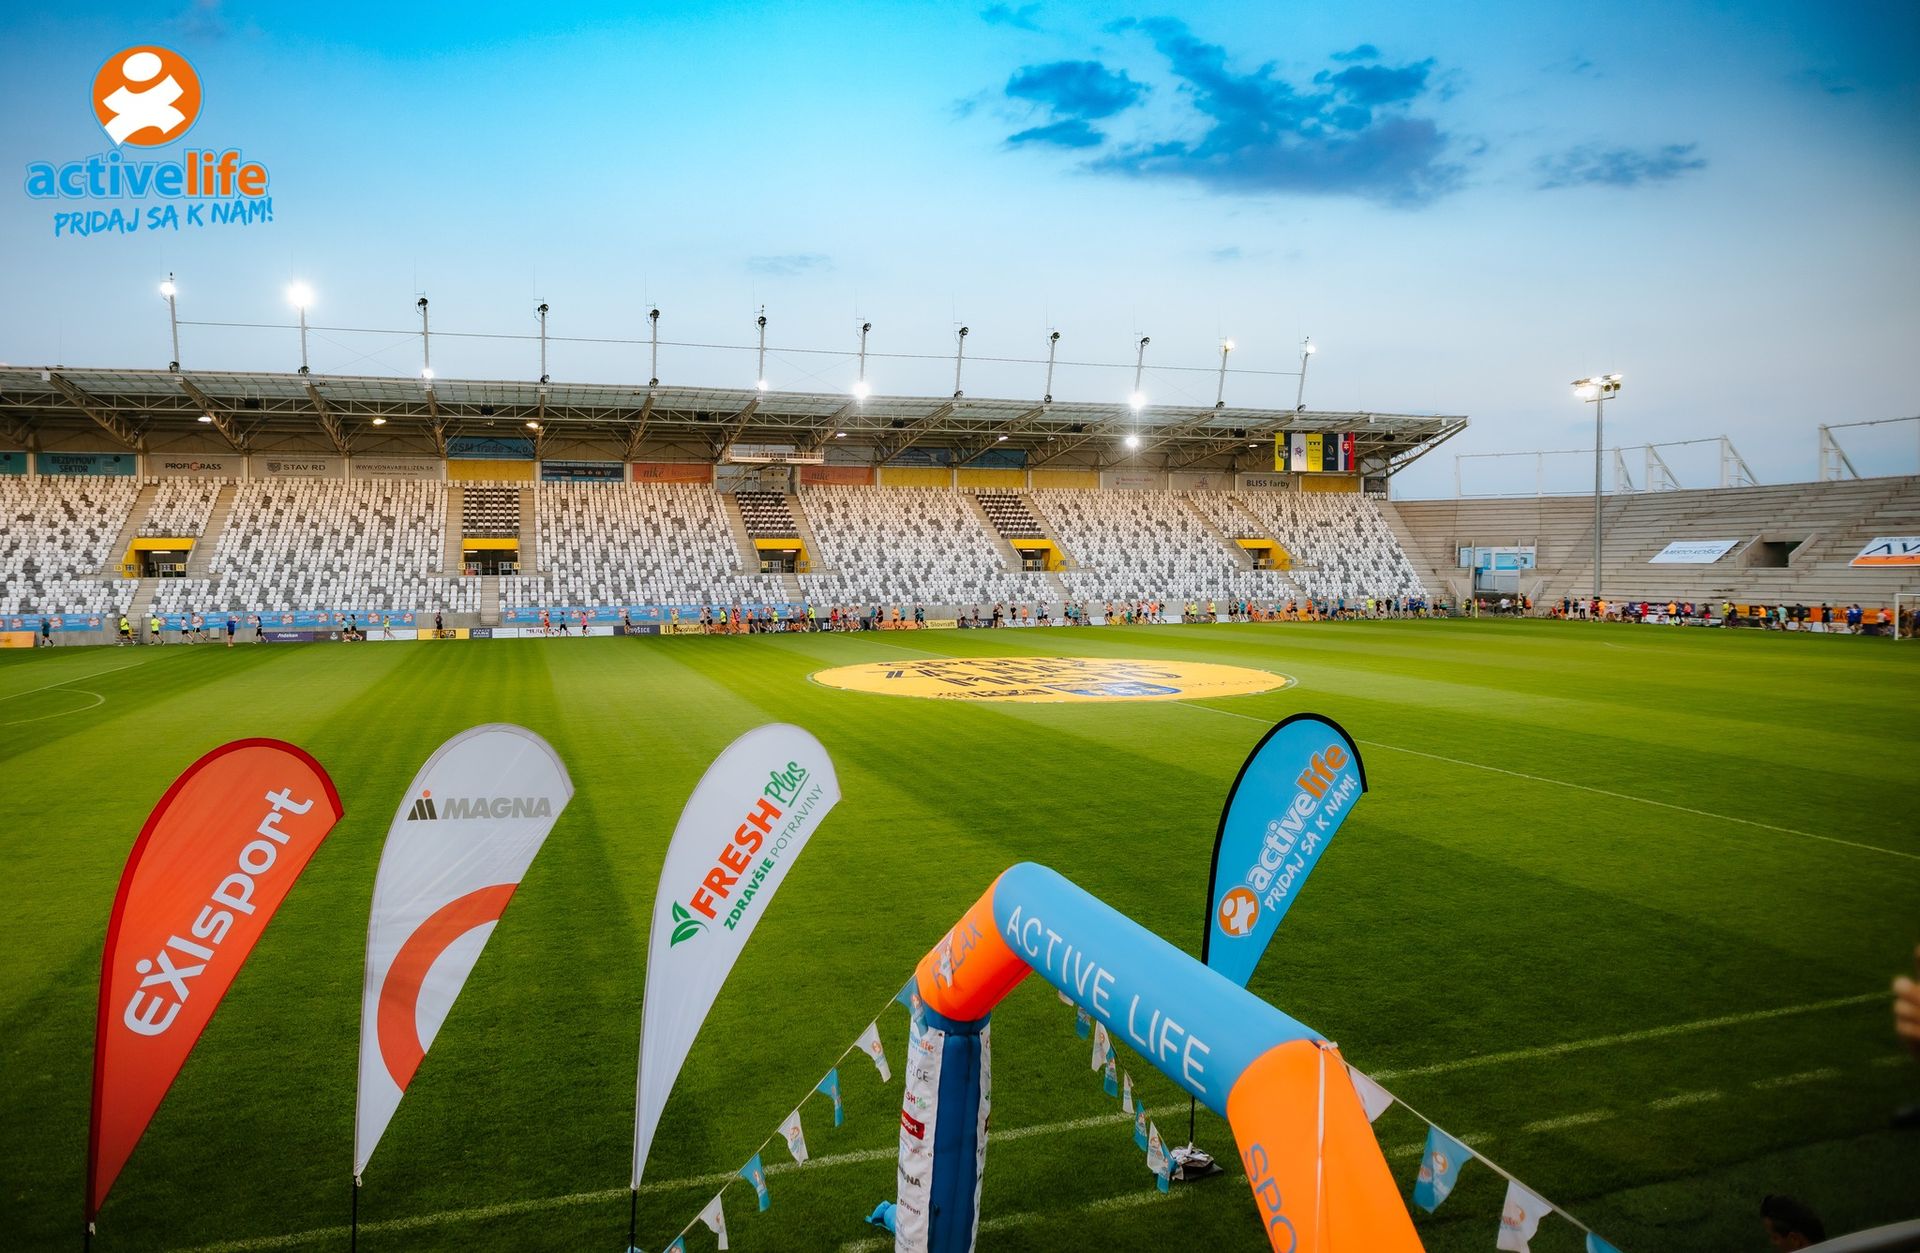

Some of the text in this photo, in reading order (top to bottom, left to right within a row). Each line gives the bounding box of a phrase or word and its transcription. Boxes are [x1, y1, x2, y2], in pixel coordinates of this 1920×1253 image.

[1246, 479, 1290, 489] BLISS farby
[442, 797, 553, 820] MAGNA
[690, 798, 783, 920] FRESH
[724, 783, 824, 931] ZDRAVŠIE POTRAVINY
[1248, 744, 1349, 892] activelife
[1263, 852, 1305, 911] PRIDAJ
[1300, 831, 1322, 855] SA
[1315, 814, 1330, 831] K
[1006, 904, 1211, 1094] ACTIVE LIFE
